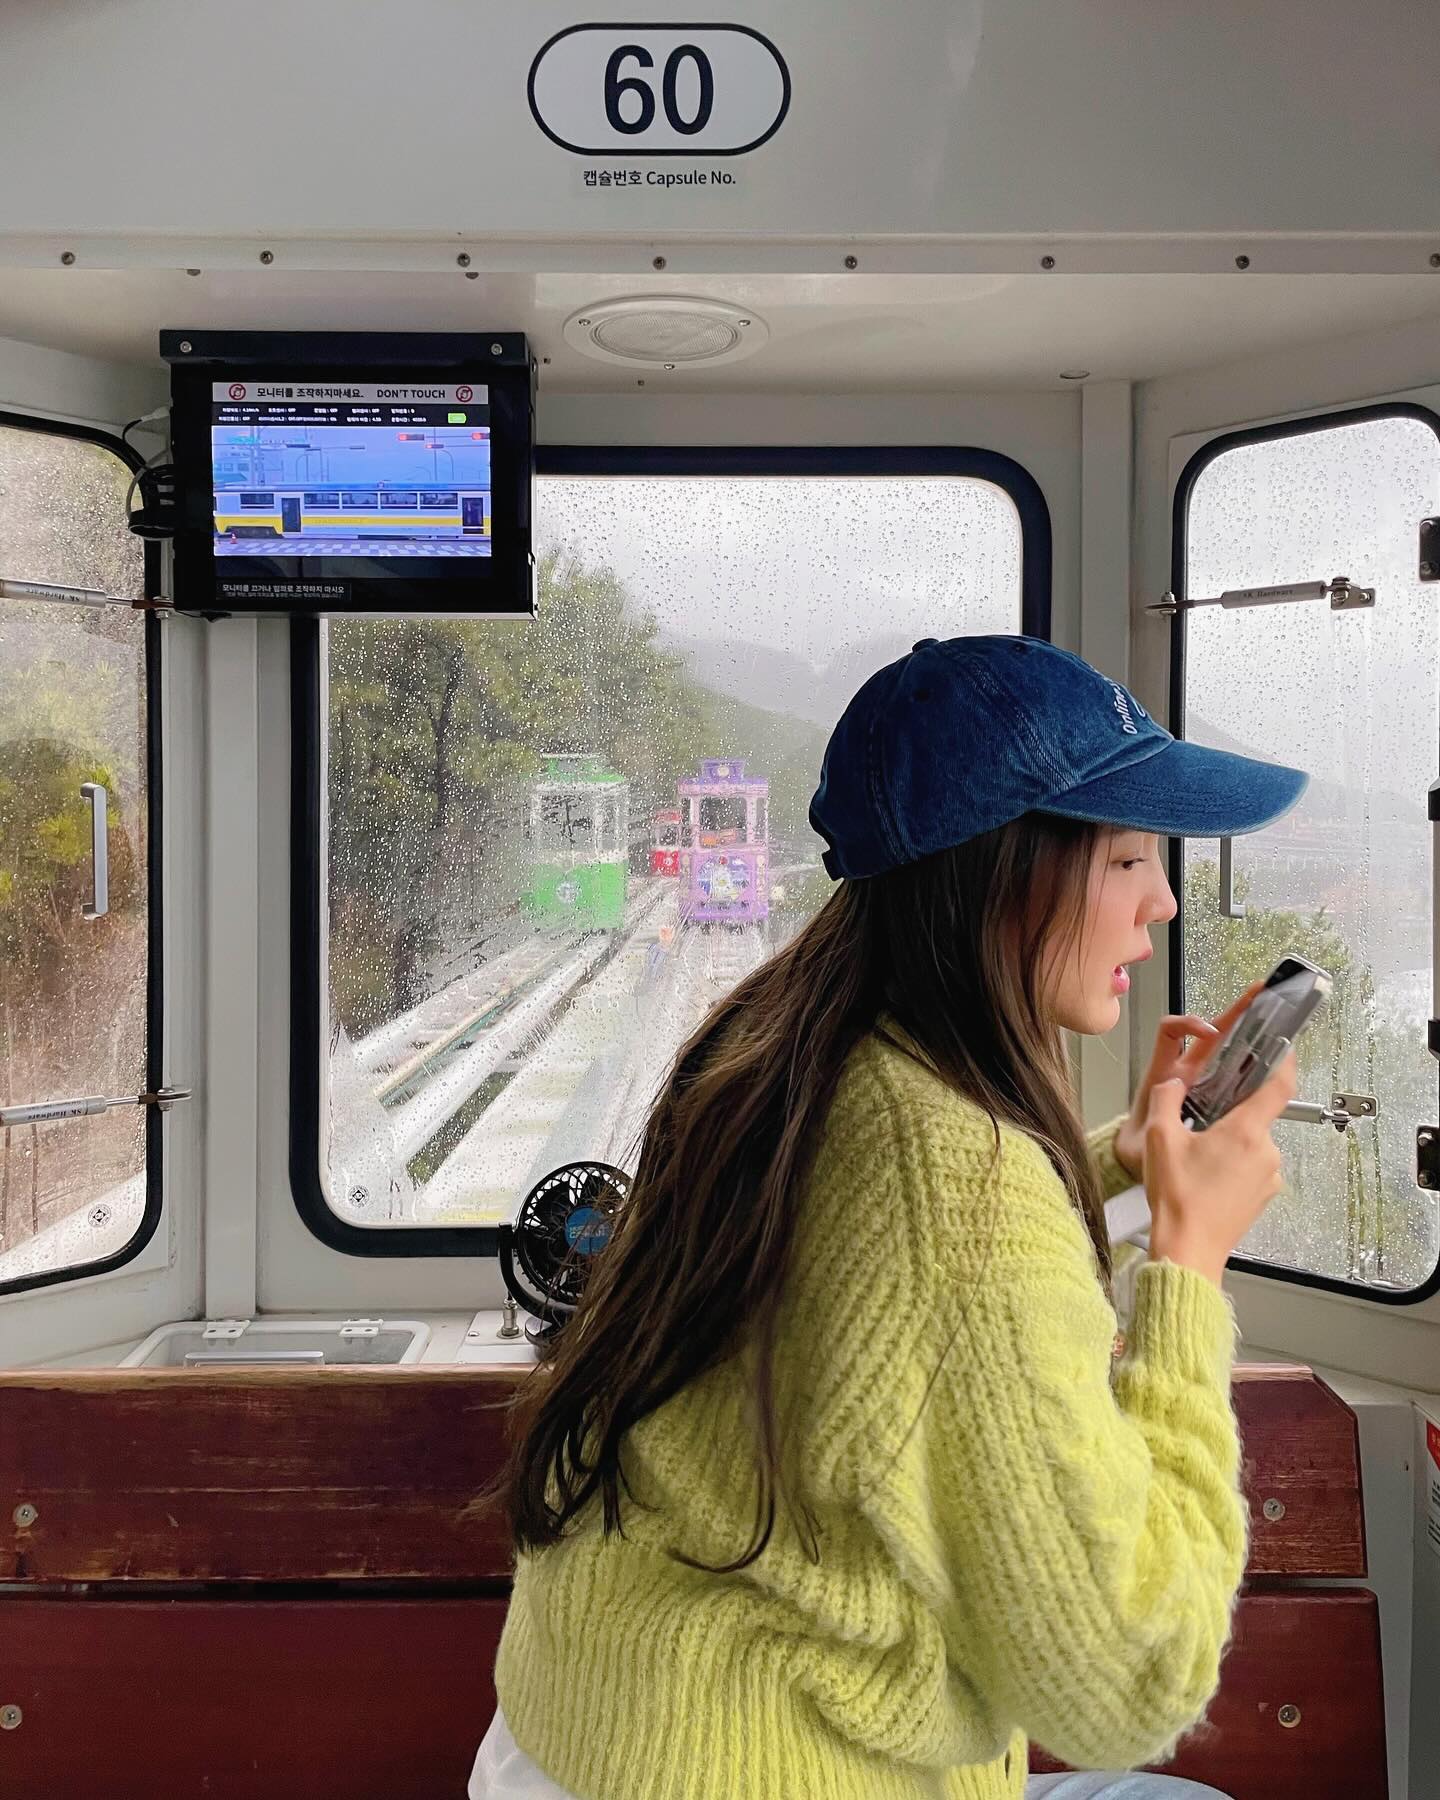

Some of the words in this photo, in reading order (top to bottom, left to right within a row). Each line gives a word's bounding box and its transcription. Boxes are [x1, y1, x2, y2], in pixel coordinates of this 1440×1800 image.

[604, 44, 714, 135] 60
[583, 170, 643, 186] 캡슐번호
[646, 170, 707, 188] Capsule
[711, 171, 736, 185] No.
[257, 387, 293, 398] 모니터를
[377, 389, 408, 399] DON'T
[411, 389, 446, 399] TOUCH
